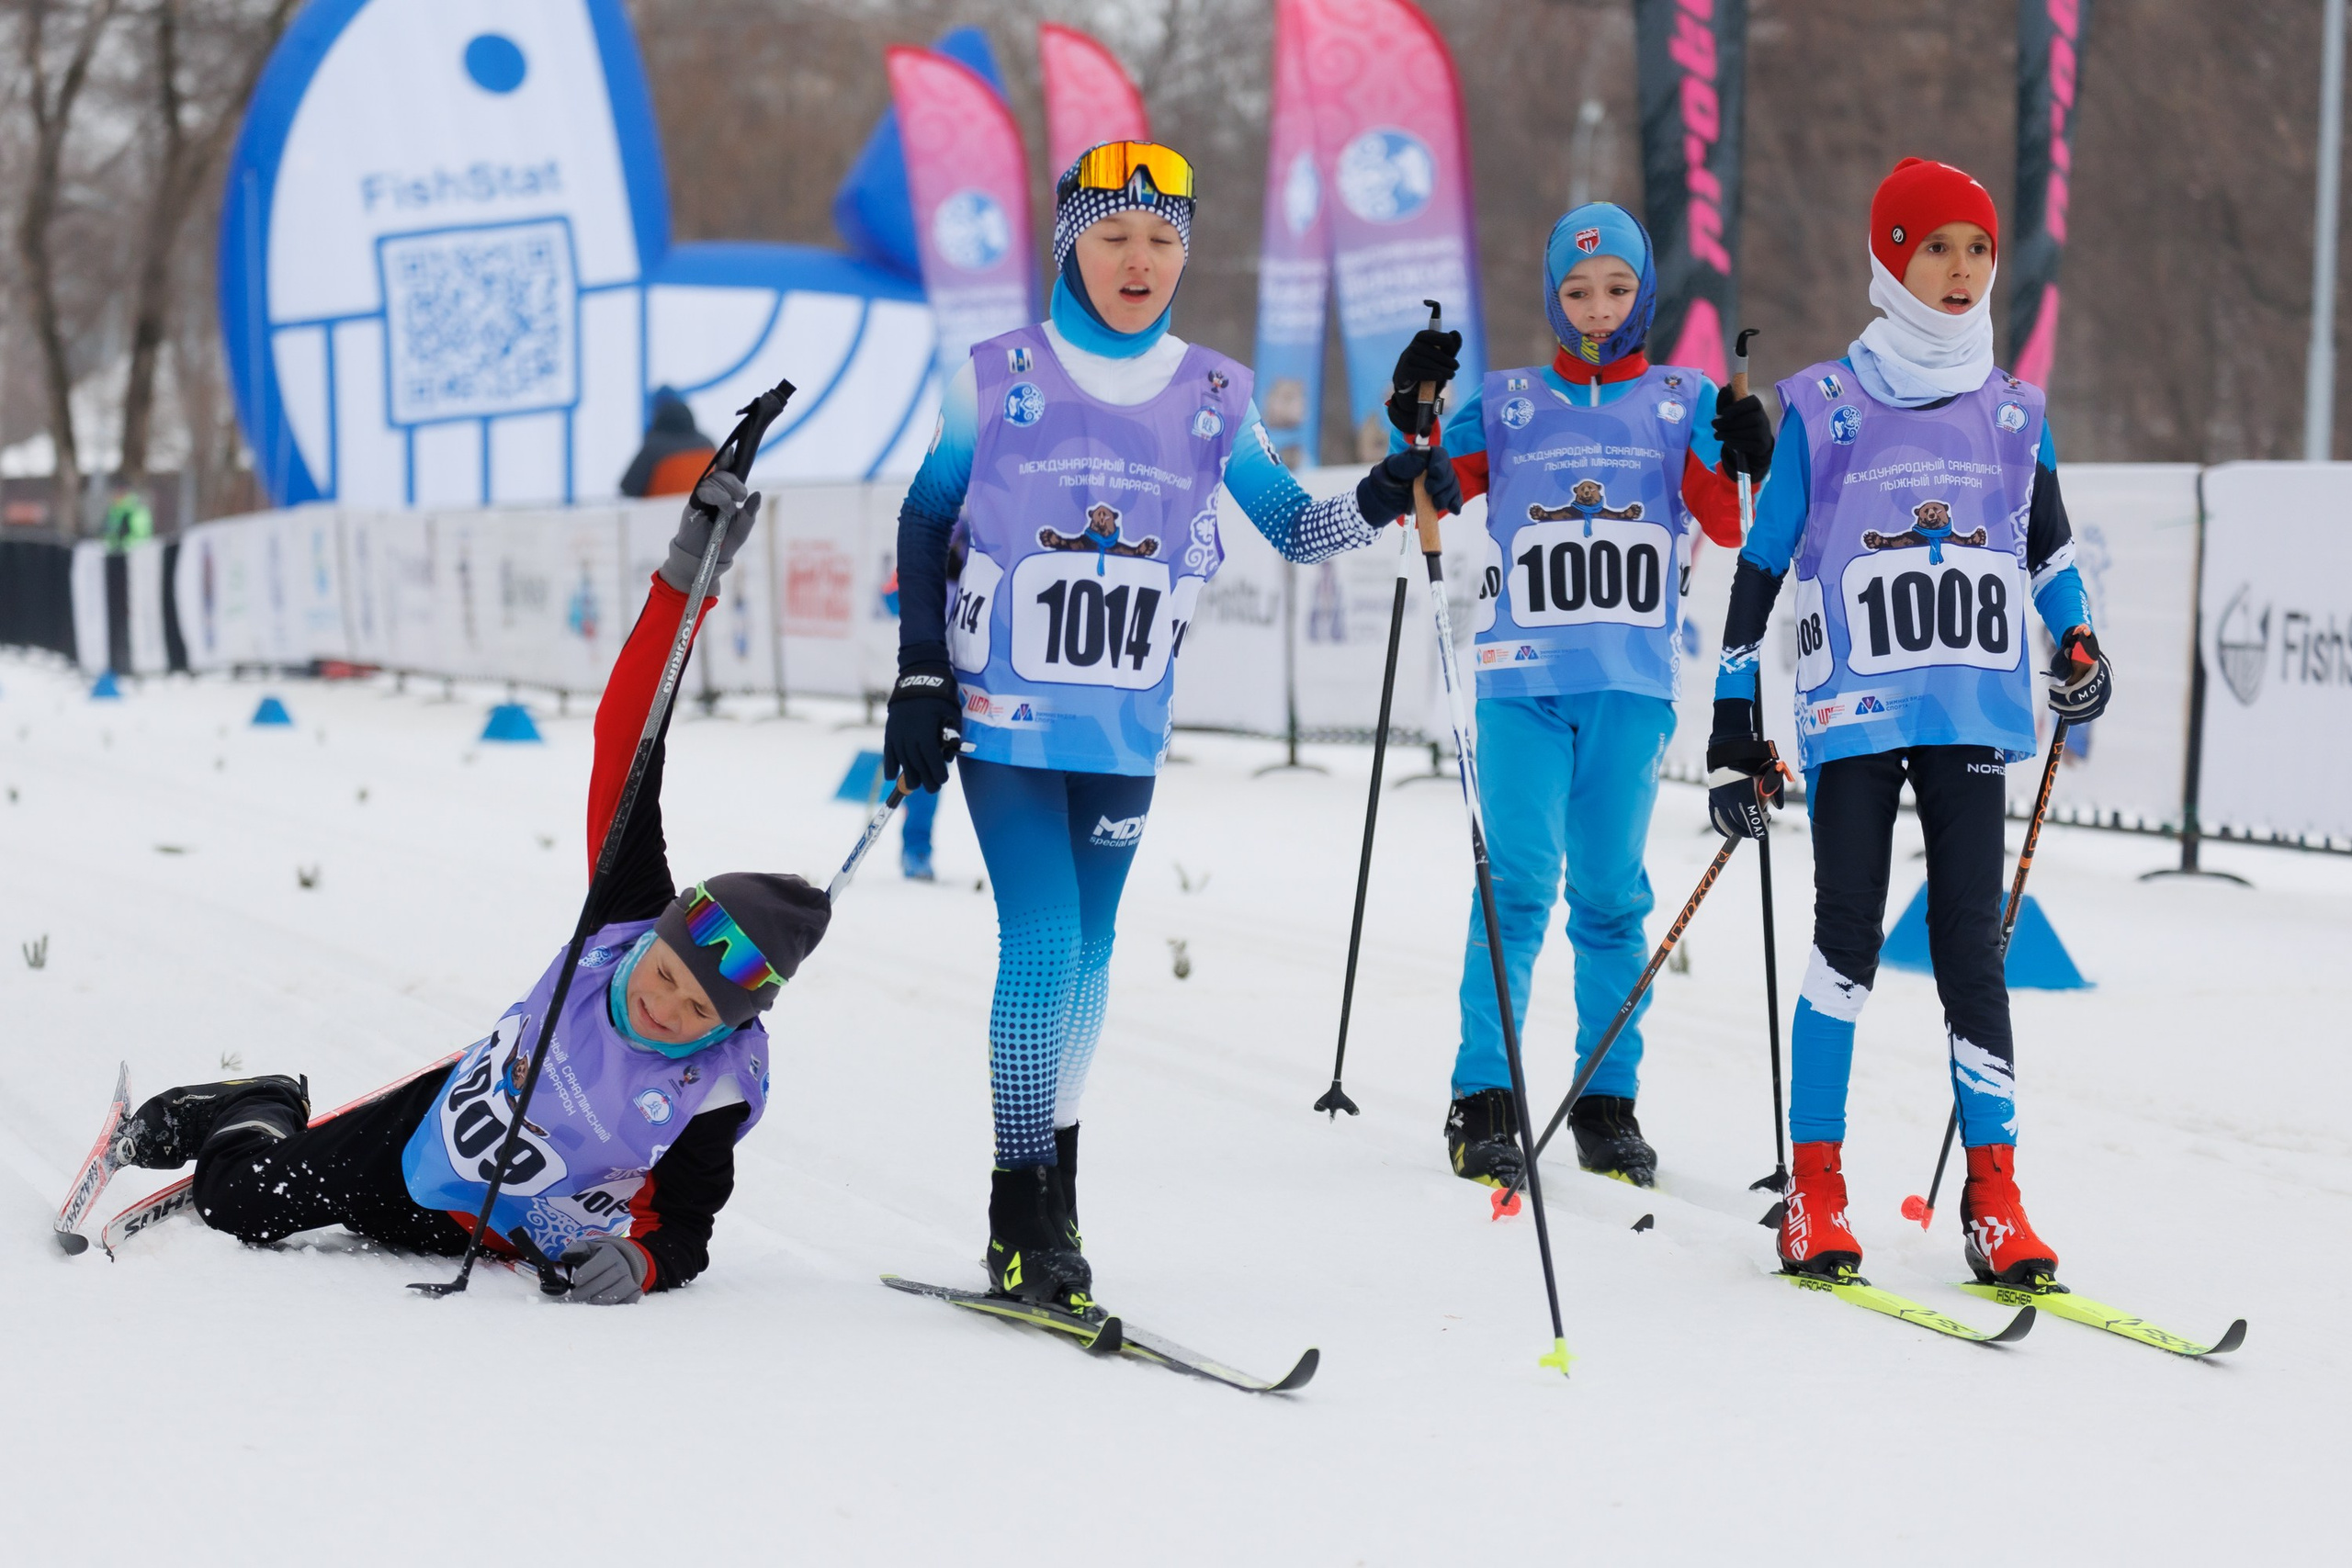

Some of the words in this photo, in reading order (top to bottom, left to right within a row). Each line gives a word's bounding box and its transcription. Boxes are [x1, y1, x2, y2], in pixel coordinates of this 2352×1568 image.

[359, 159, 563, 214] FishStat
[1109, 476, 1161, 497] МАРАФО
[1590, 457, 1642, 470] МАРАФОН
[1879, 473, 1930, 492] ЛЫЖНЫЙ
[1934, 475, 1983, 490] МАРАФОН
[1517, 539, 1661, 615] 1000
[1035, 578, 1162, 671] 1014
[1857, 567, 2010, 658] 1008
[662, 616, 695, 694] TOURING
[2280, 608, 2352, 686] Fish
[1886, 704, 1908, 712] СПОРТА
[2077, 670, 2106, 701] MOAX
[1089, 836, 1127, 848] special
[1747, 805, 1766, 838] MOAX
[448, 1030, 548, 1186] 009
[542, 1055, 577, 1117] МАРАФОН
[561, 1061, 613, 1144] САХАЛИНСКИЙ
[1784, 1176, 1809, 1261] alpine
[1798, 1279, 1833, 1292] FISCHER
[1996, 1289, 2032, 1306] FISCHER
